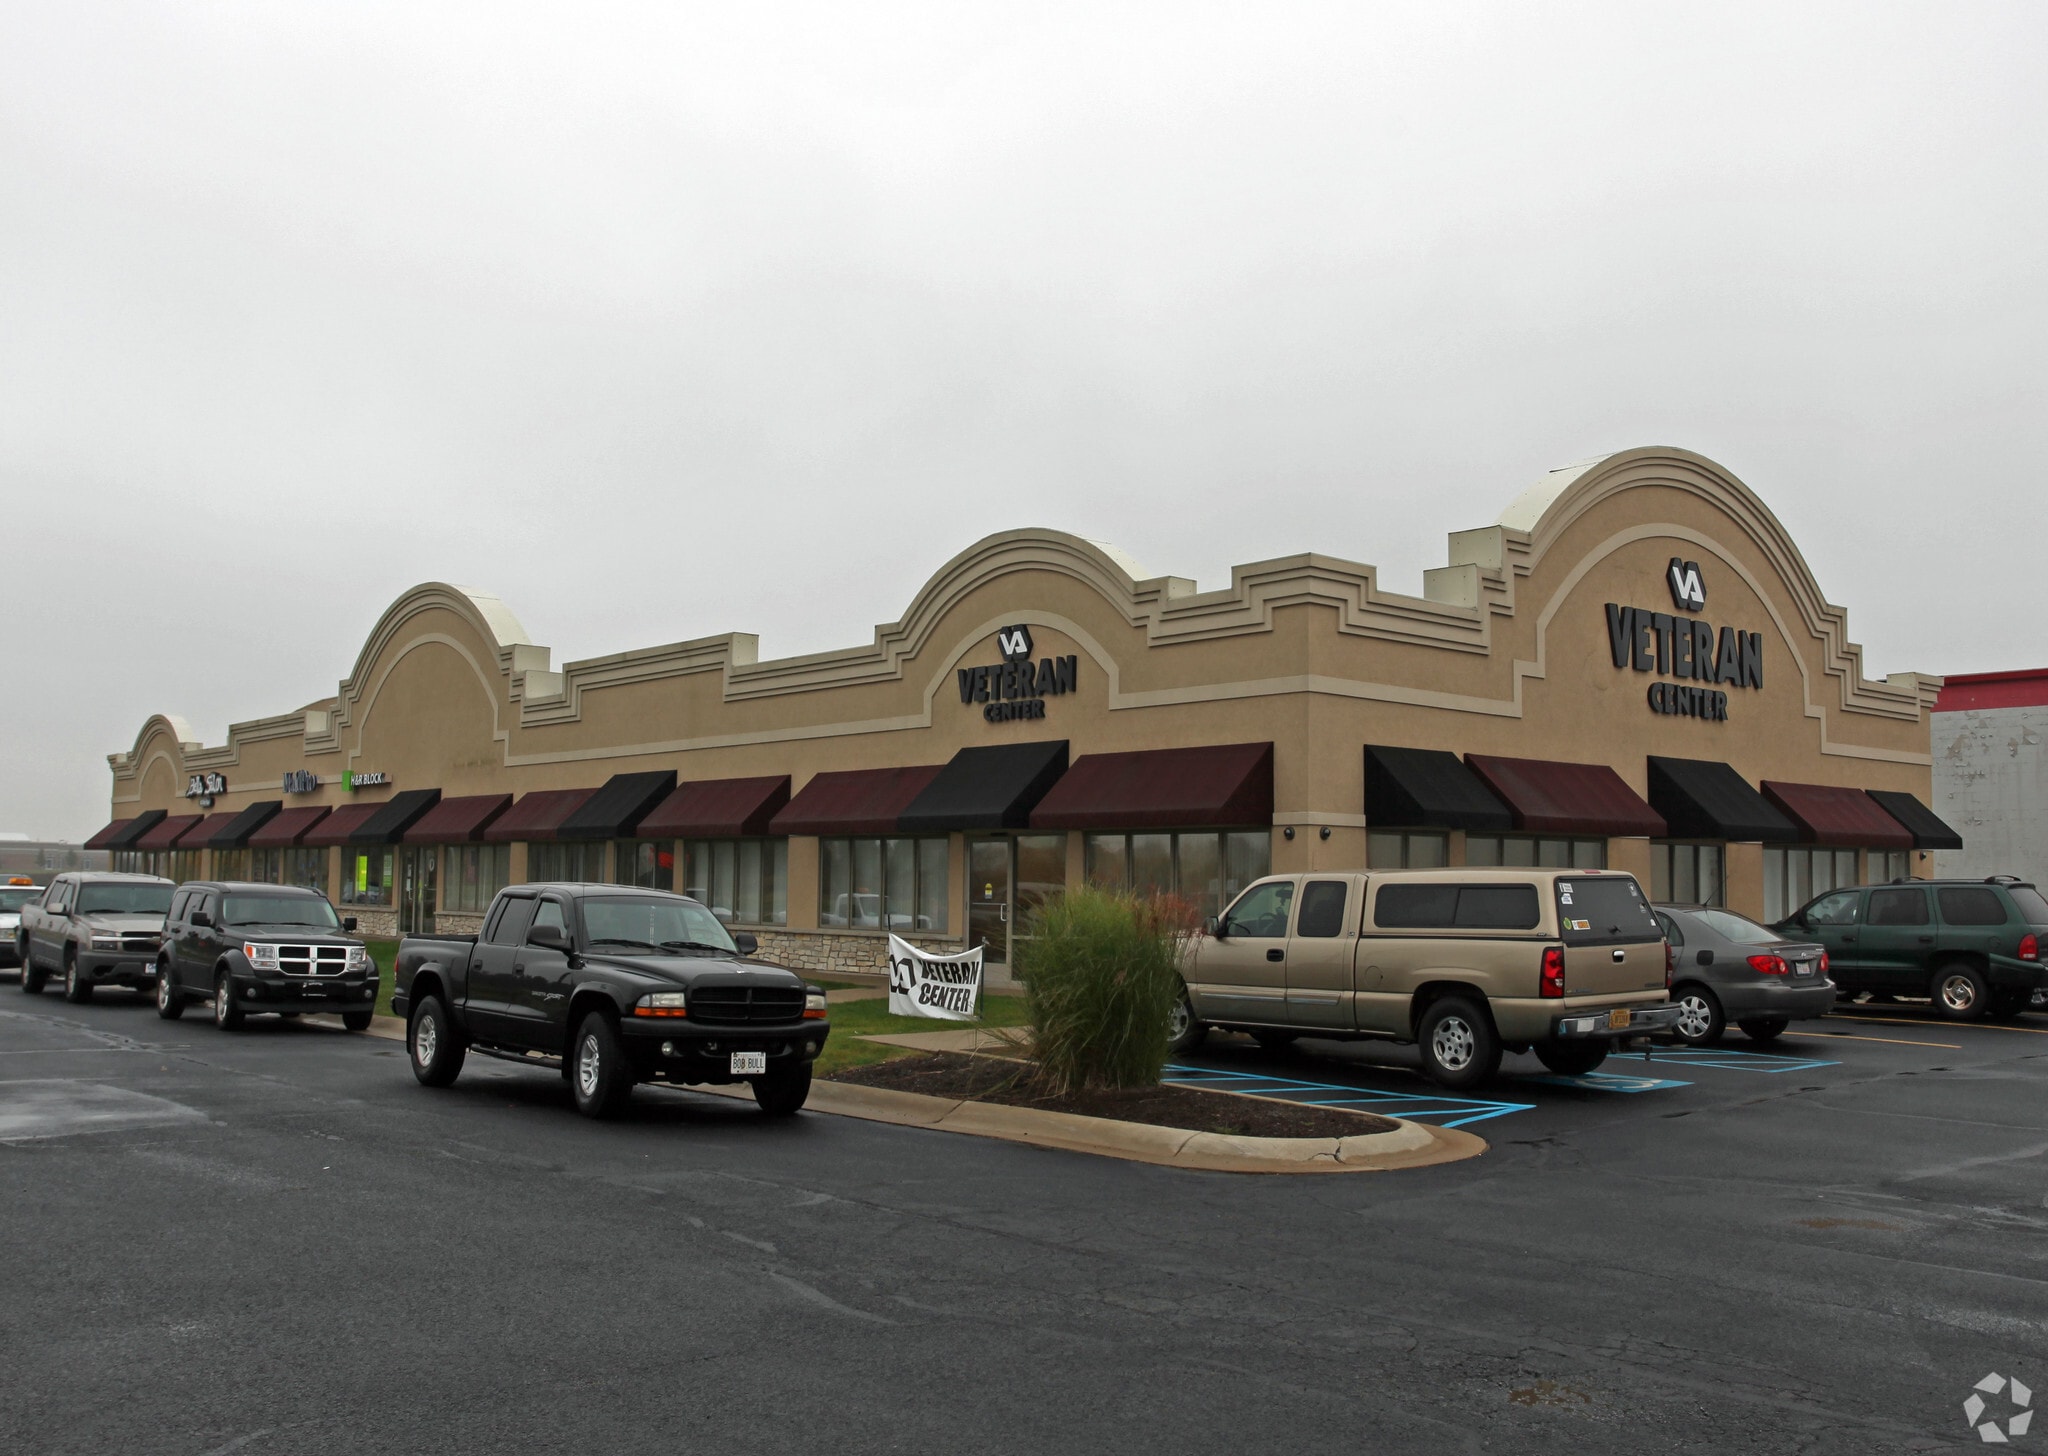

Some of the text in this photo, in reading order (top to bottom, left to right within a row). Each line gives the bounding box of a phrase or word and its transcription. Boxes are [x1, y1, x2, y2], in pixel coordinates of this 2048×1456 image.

[1671, 565, 1705, 604] VA
[999, 629, 1028, 656] VA
[1605, 602, 1763, 690] VETERAN
[957, 654, 1078, 705] VETERAN
[983, 699, 1046, 723] CENTER
[1647, 681, 1729, 721] CENTER
[350, 772, 384, 787] H&R BLOCK
[917, 958, 980, 986] VETERAN
[918, 982, 971, 1013] CENTER
[748, 1058, 764, 1069] BULL
